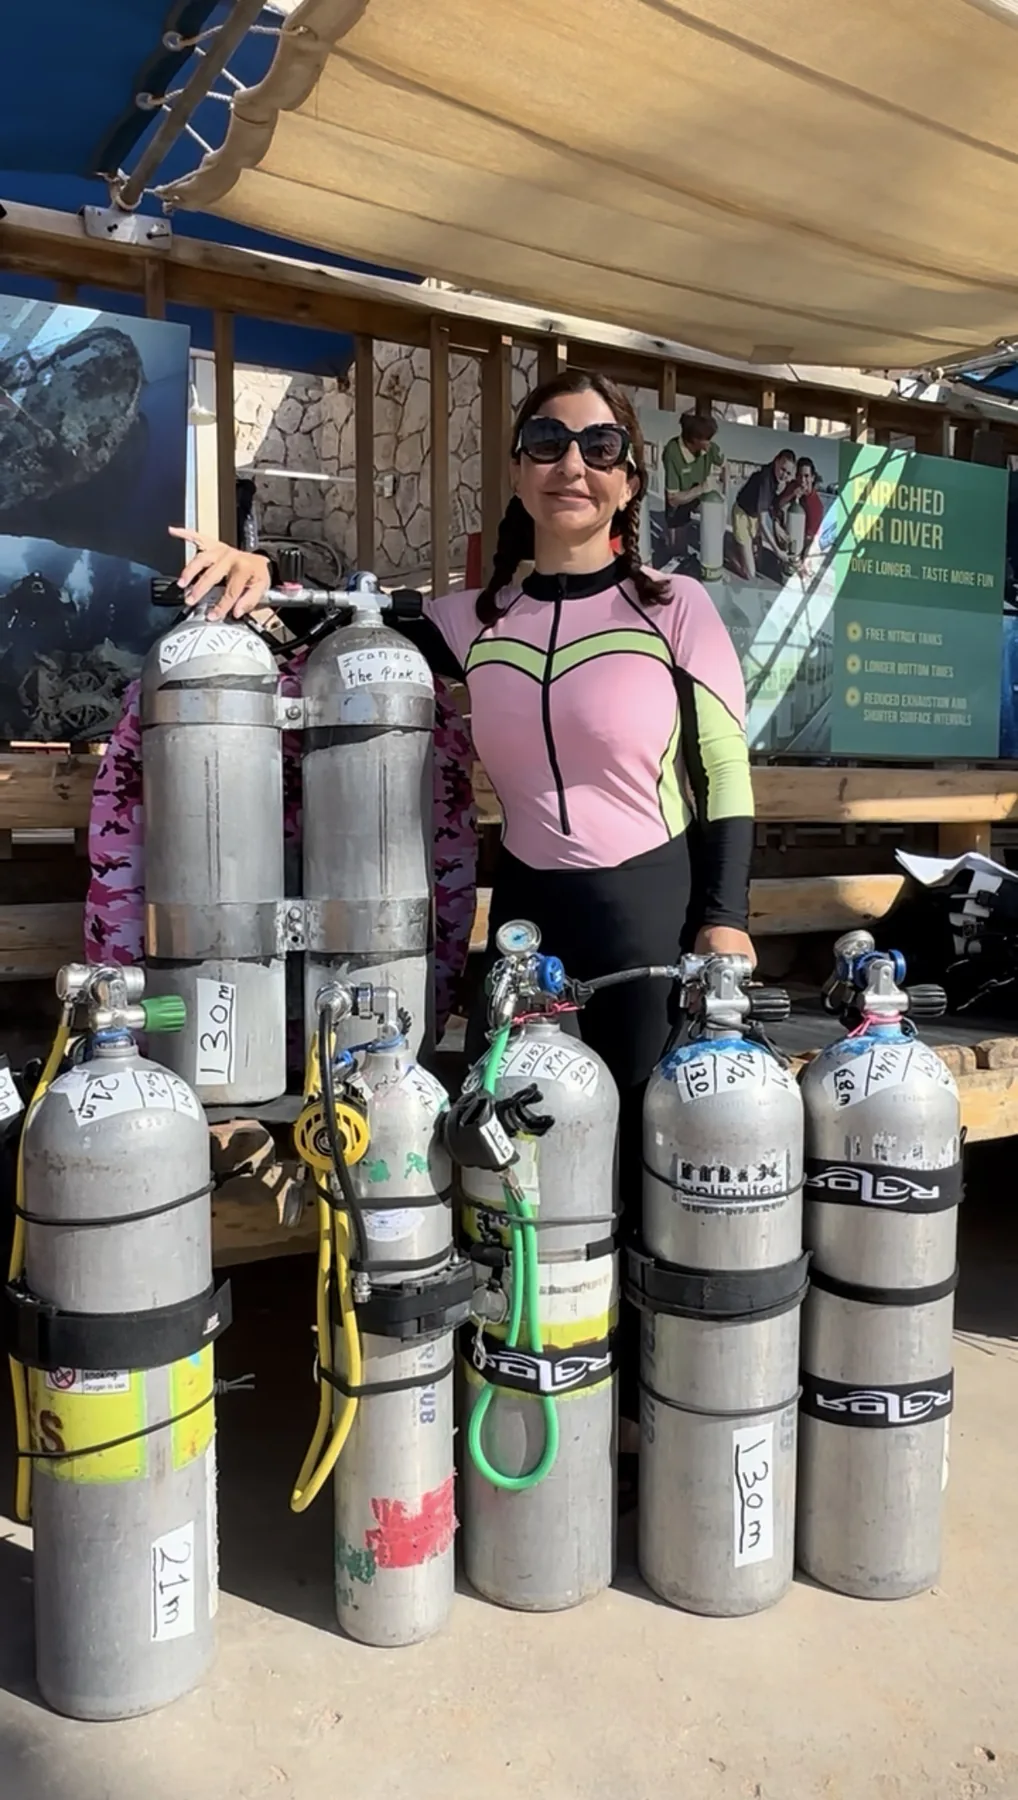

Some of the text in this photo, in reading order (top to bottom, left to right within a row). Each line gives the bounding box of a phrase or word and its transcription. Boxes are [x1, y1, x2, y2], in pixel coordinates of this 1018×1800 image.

[853, 477, 944, 516] ENRICHED
[853, 513, 944, 549] AIR DIVER
[851, 557, 873, 573] DIVE
[922, 566, 949, 582] TASTE
[951, 570, 975, 586] MORE
[977, 574, 994, 588] FUN
[865, 627, 885, 640] FREE
[888, 629, 918, 643] NITROX
[348, 668, 373, 685] the
[865, 660, 954, 678] LONGER BOTTOM TIMES
[864, 692, 967, 709] REDUCED EXHAUSTION AND
[864, 709, 972, 726] SHORTER SURFACE INTERVALS
[200, 984, 231, 1074] 130m
[82, 1078, 120, 1119] 21m
[741, 1438, 769, 1549] 130m
[159, 1541, 191, 1624] 21m
